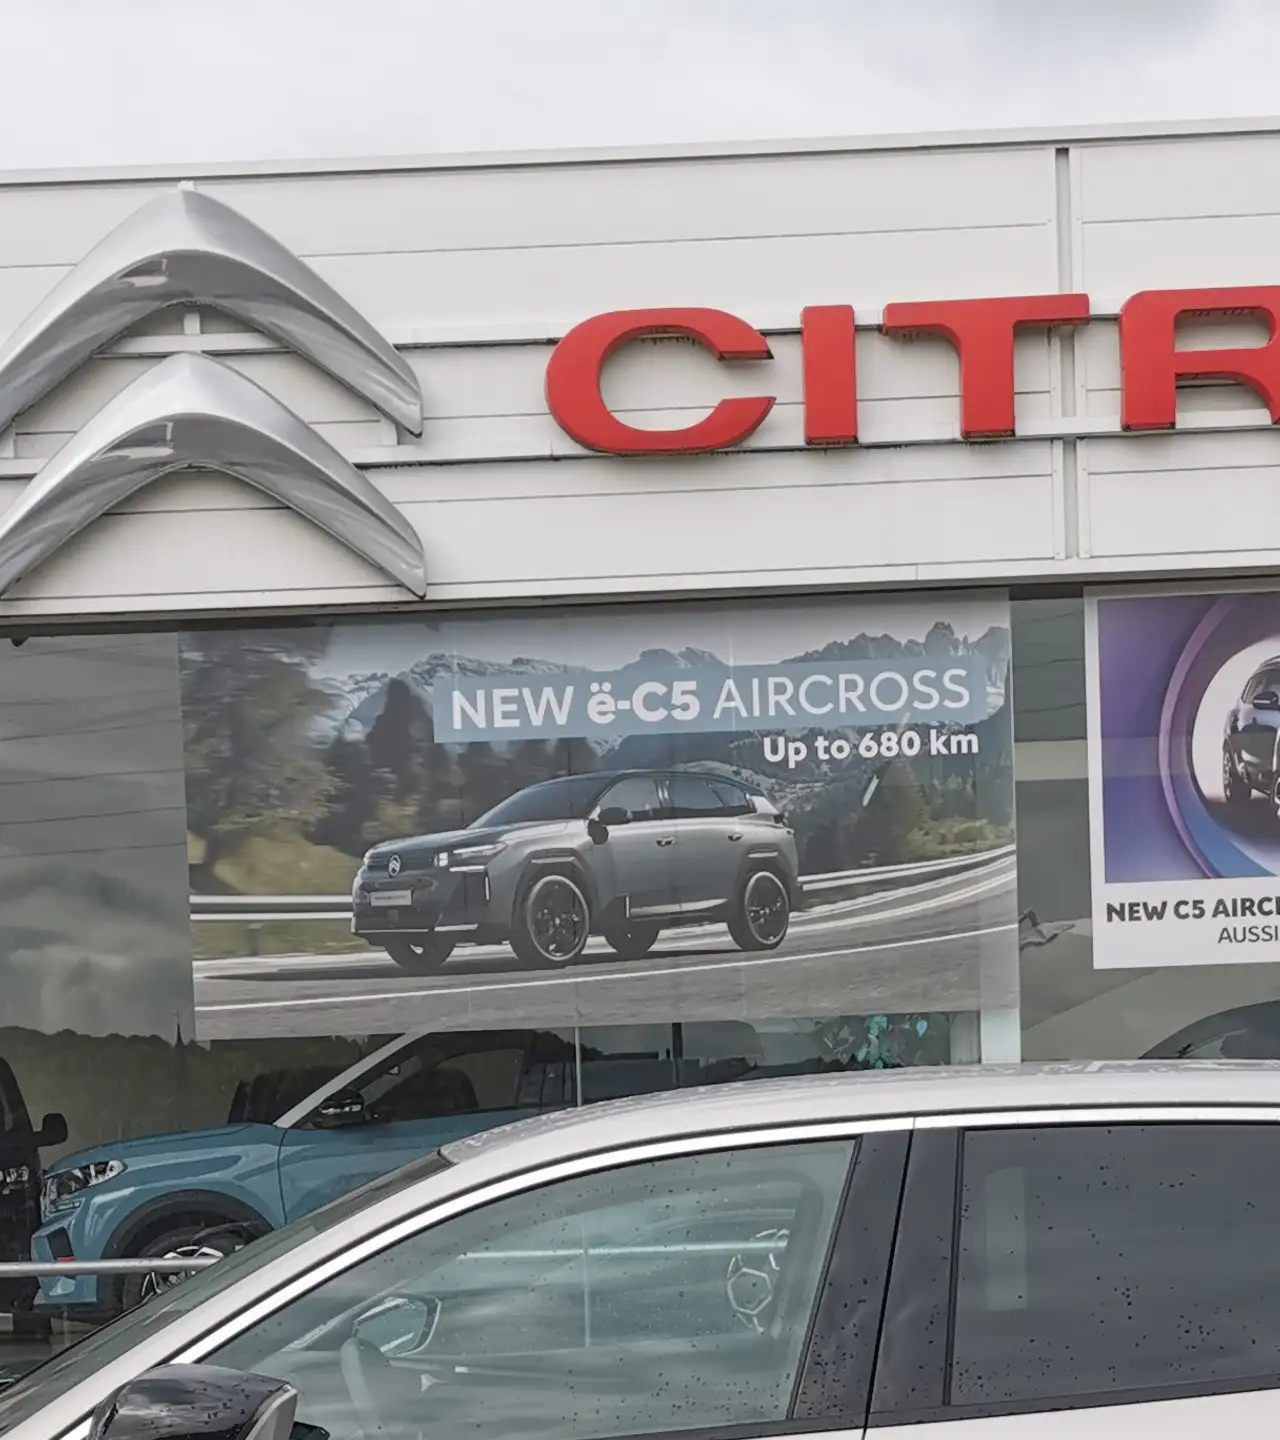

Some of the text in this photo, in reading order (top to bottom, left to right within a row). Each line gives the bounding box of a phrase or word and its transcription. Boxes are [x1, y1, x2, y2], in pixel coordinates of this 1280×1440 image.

[452, 668, 971, 730] NEW ë-C5 AIRCROSS
[762, 730, 979, 769] Up to 680 km
[1106, 901, 1168, 923] NEW
[1173, 899, 1206, 919] C5
[1217, 925, 1279, 944] AUSSI
